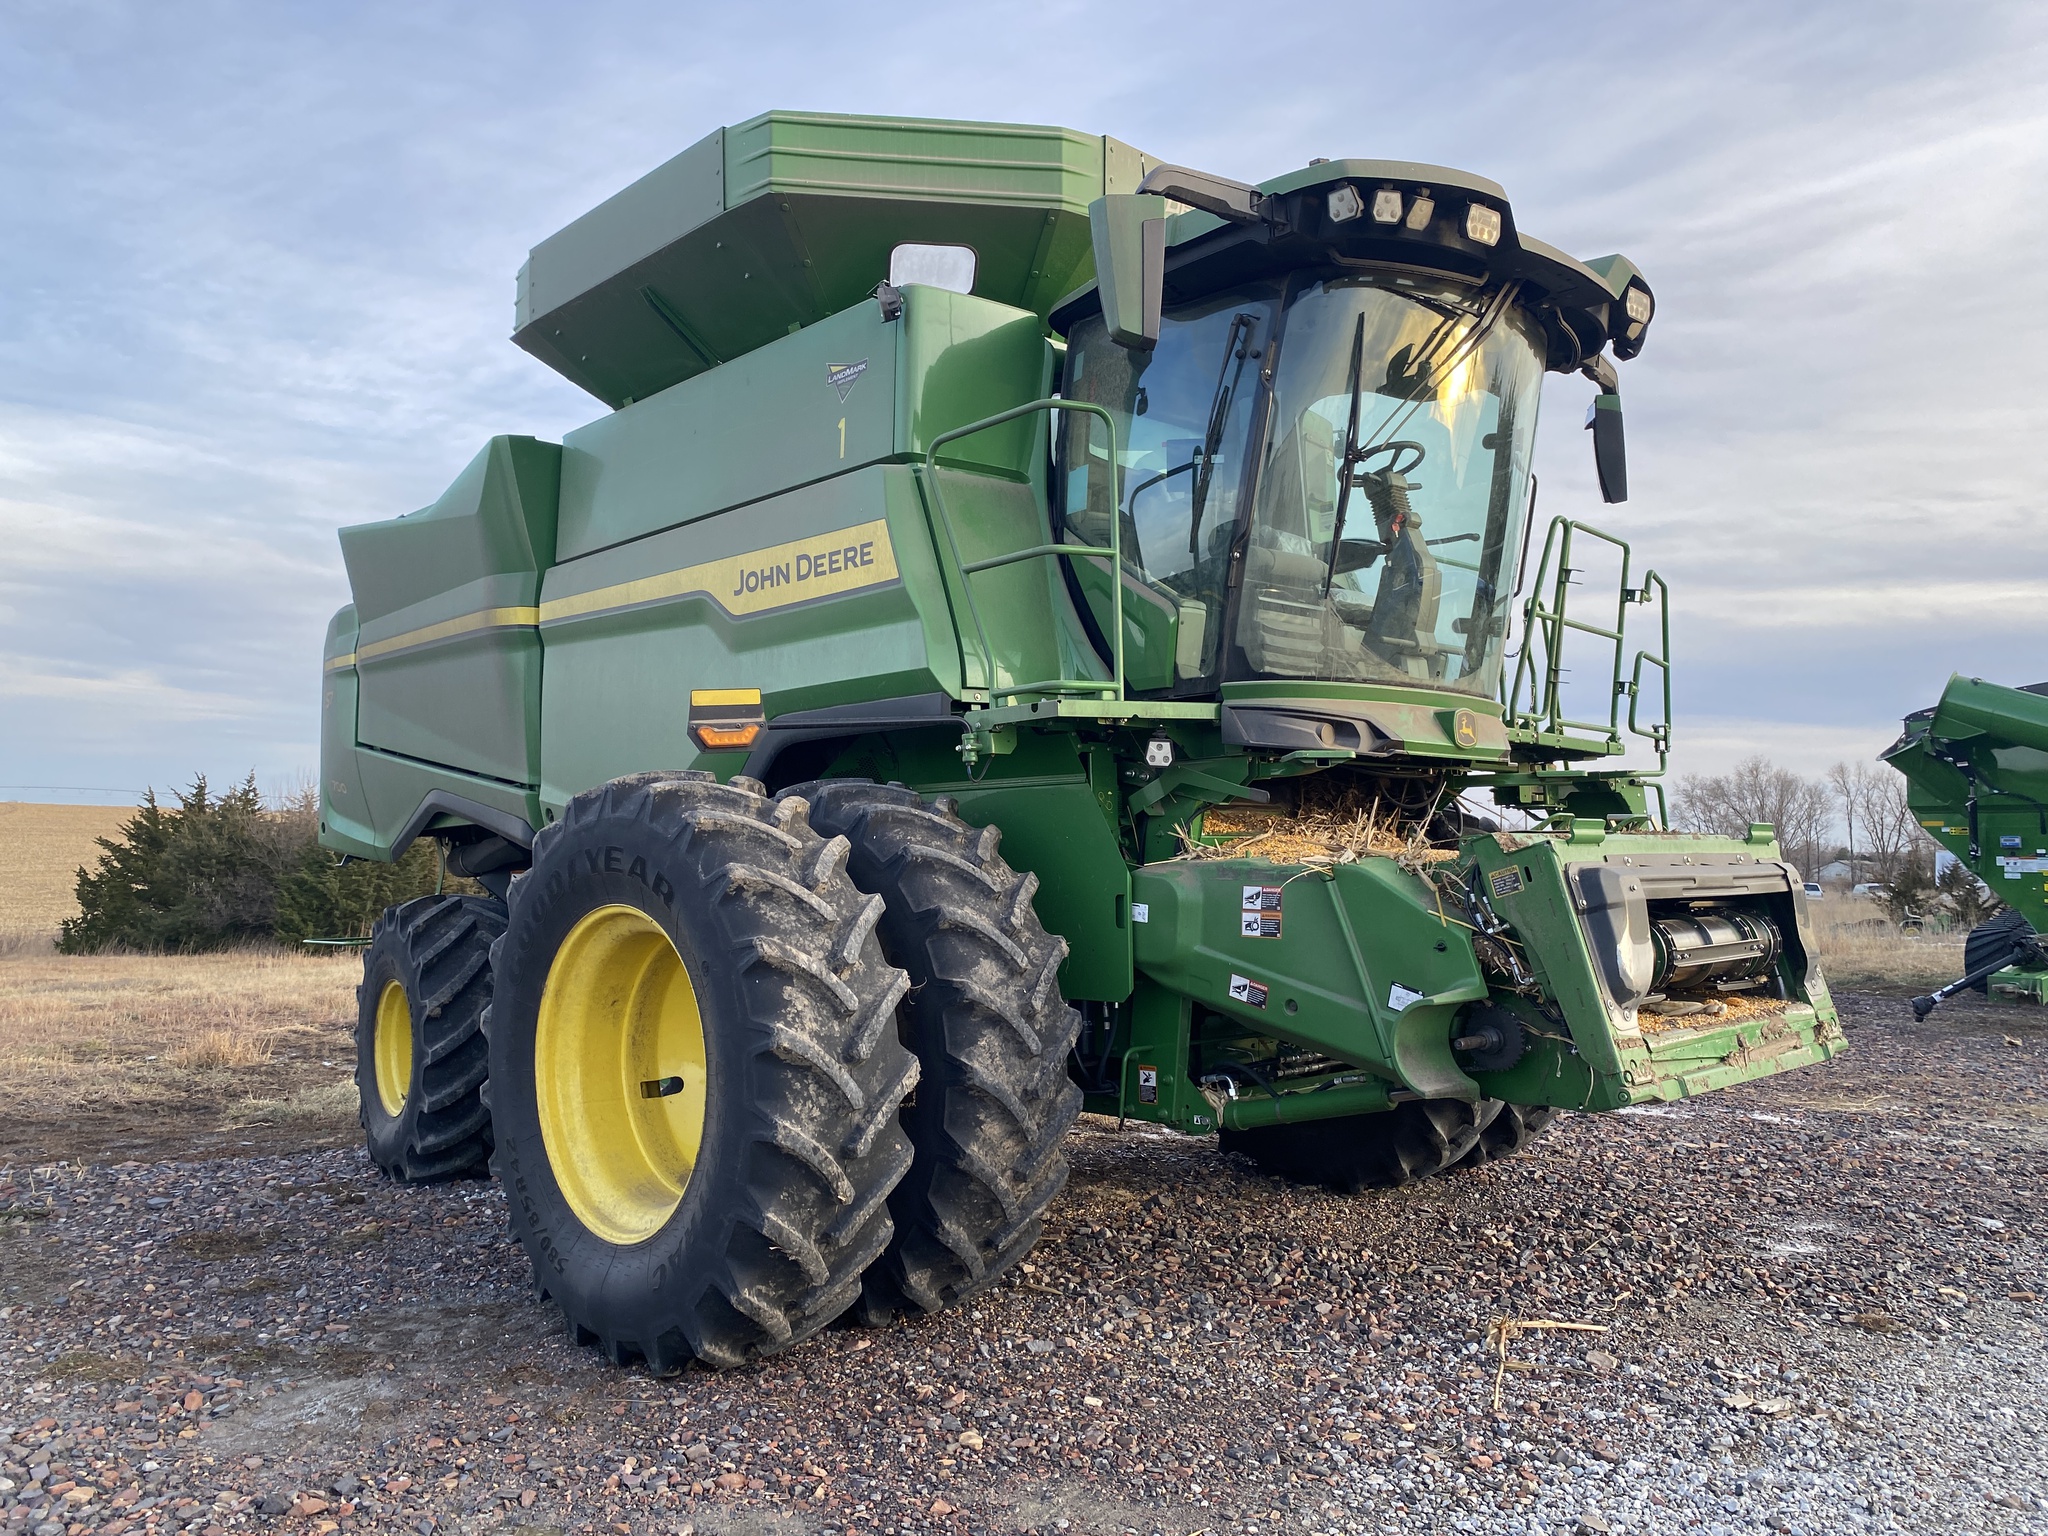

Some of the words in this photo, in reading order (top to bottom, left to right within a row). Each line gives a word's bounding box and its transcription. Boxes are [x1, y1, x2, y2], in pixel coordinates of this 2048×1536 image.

[827, 362, 867, 384] LANDMARK
[837, 416, 846, 459] 1
[733, 562, 791, 597] JOHN
[795, 541, 874, 582] DEERE
